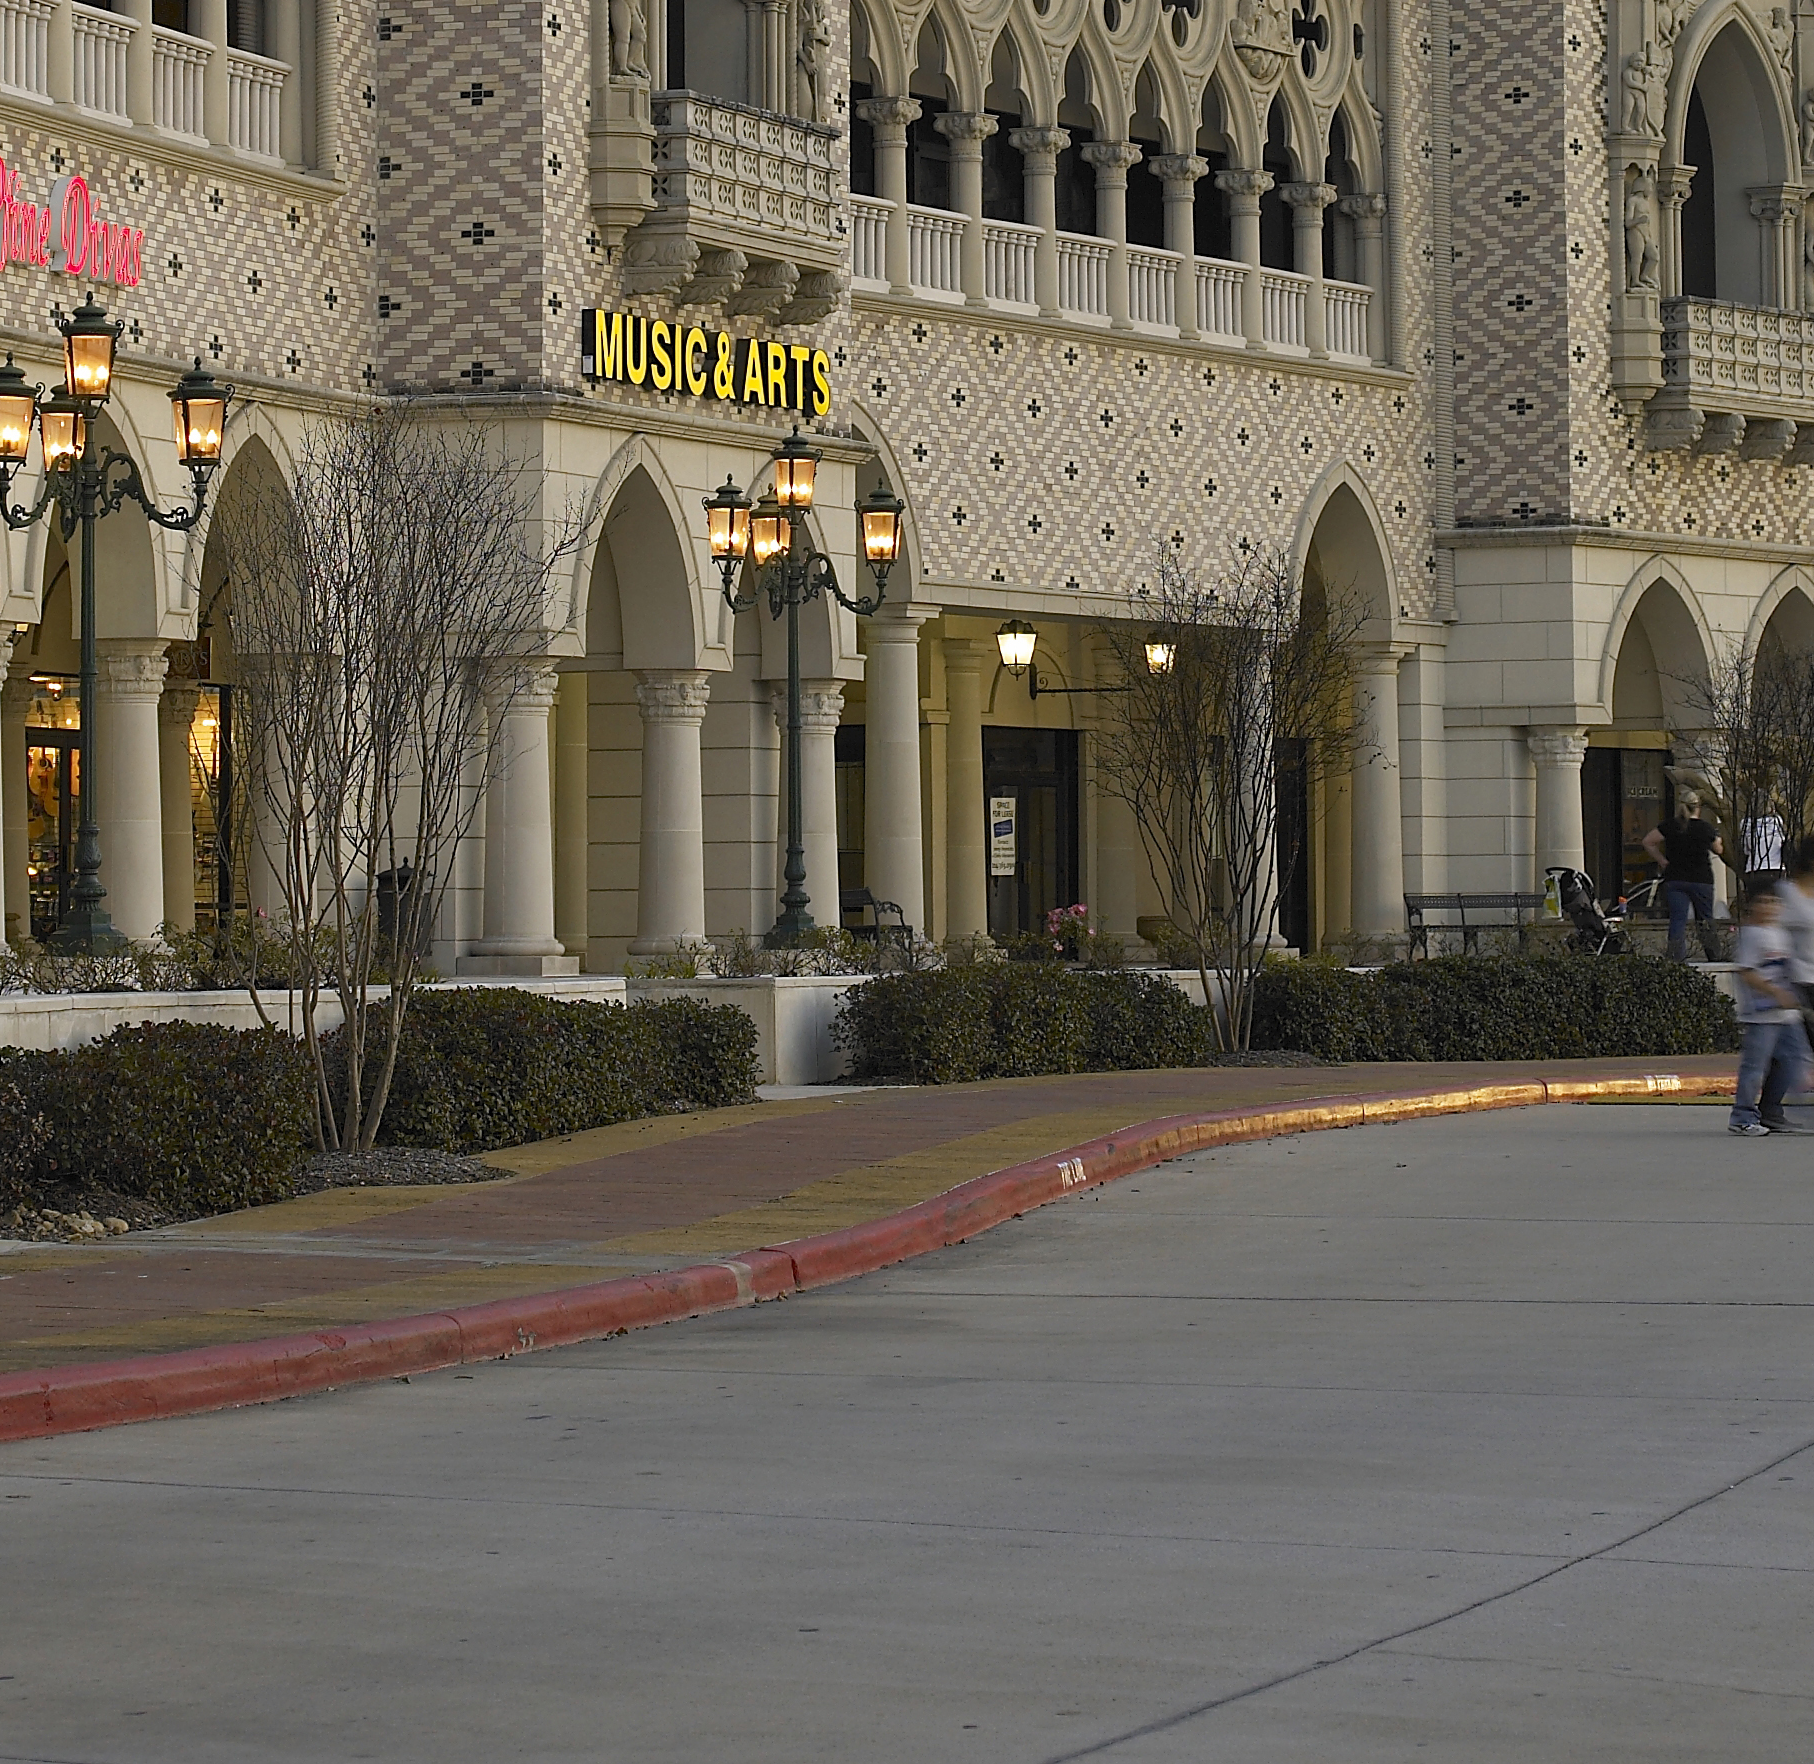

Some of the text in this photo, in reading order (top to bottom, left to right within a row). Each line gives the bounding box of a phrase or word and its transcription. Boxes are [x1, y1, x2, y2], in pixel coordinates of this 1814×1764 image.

[61, 175, 144, 287] Divas
[594, 308, 831, 416] MUSIC & ARTS
